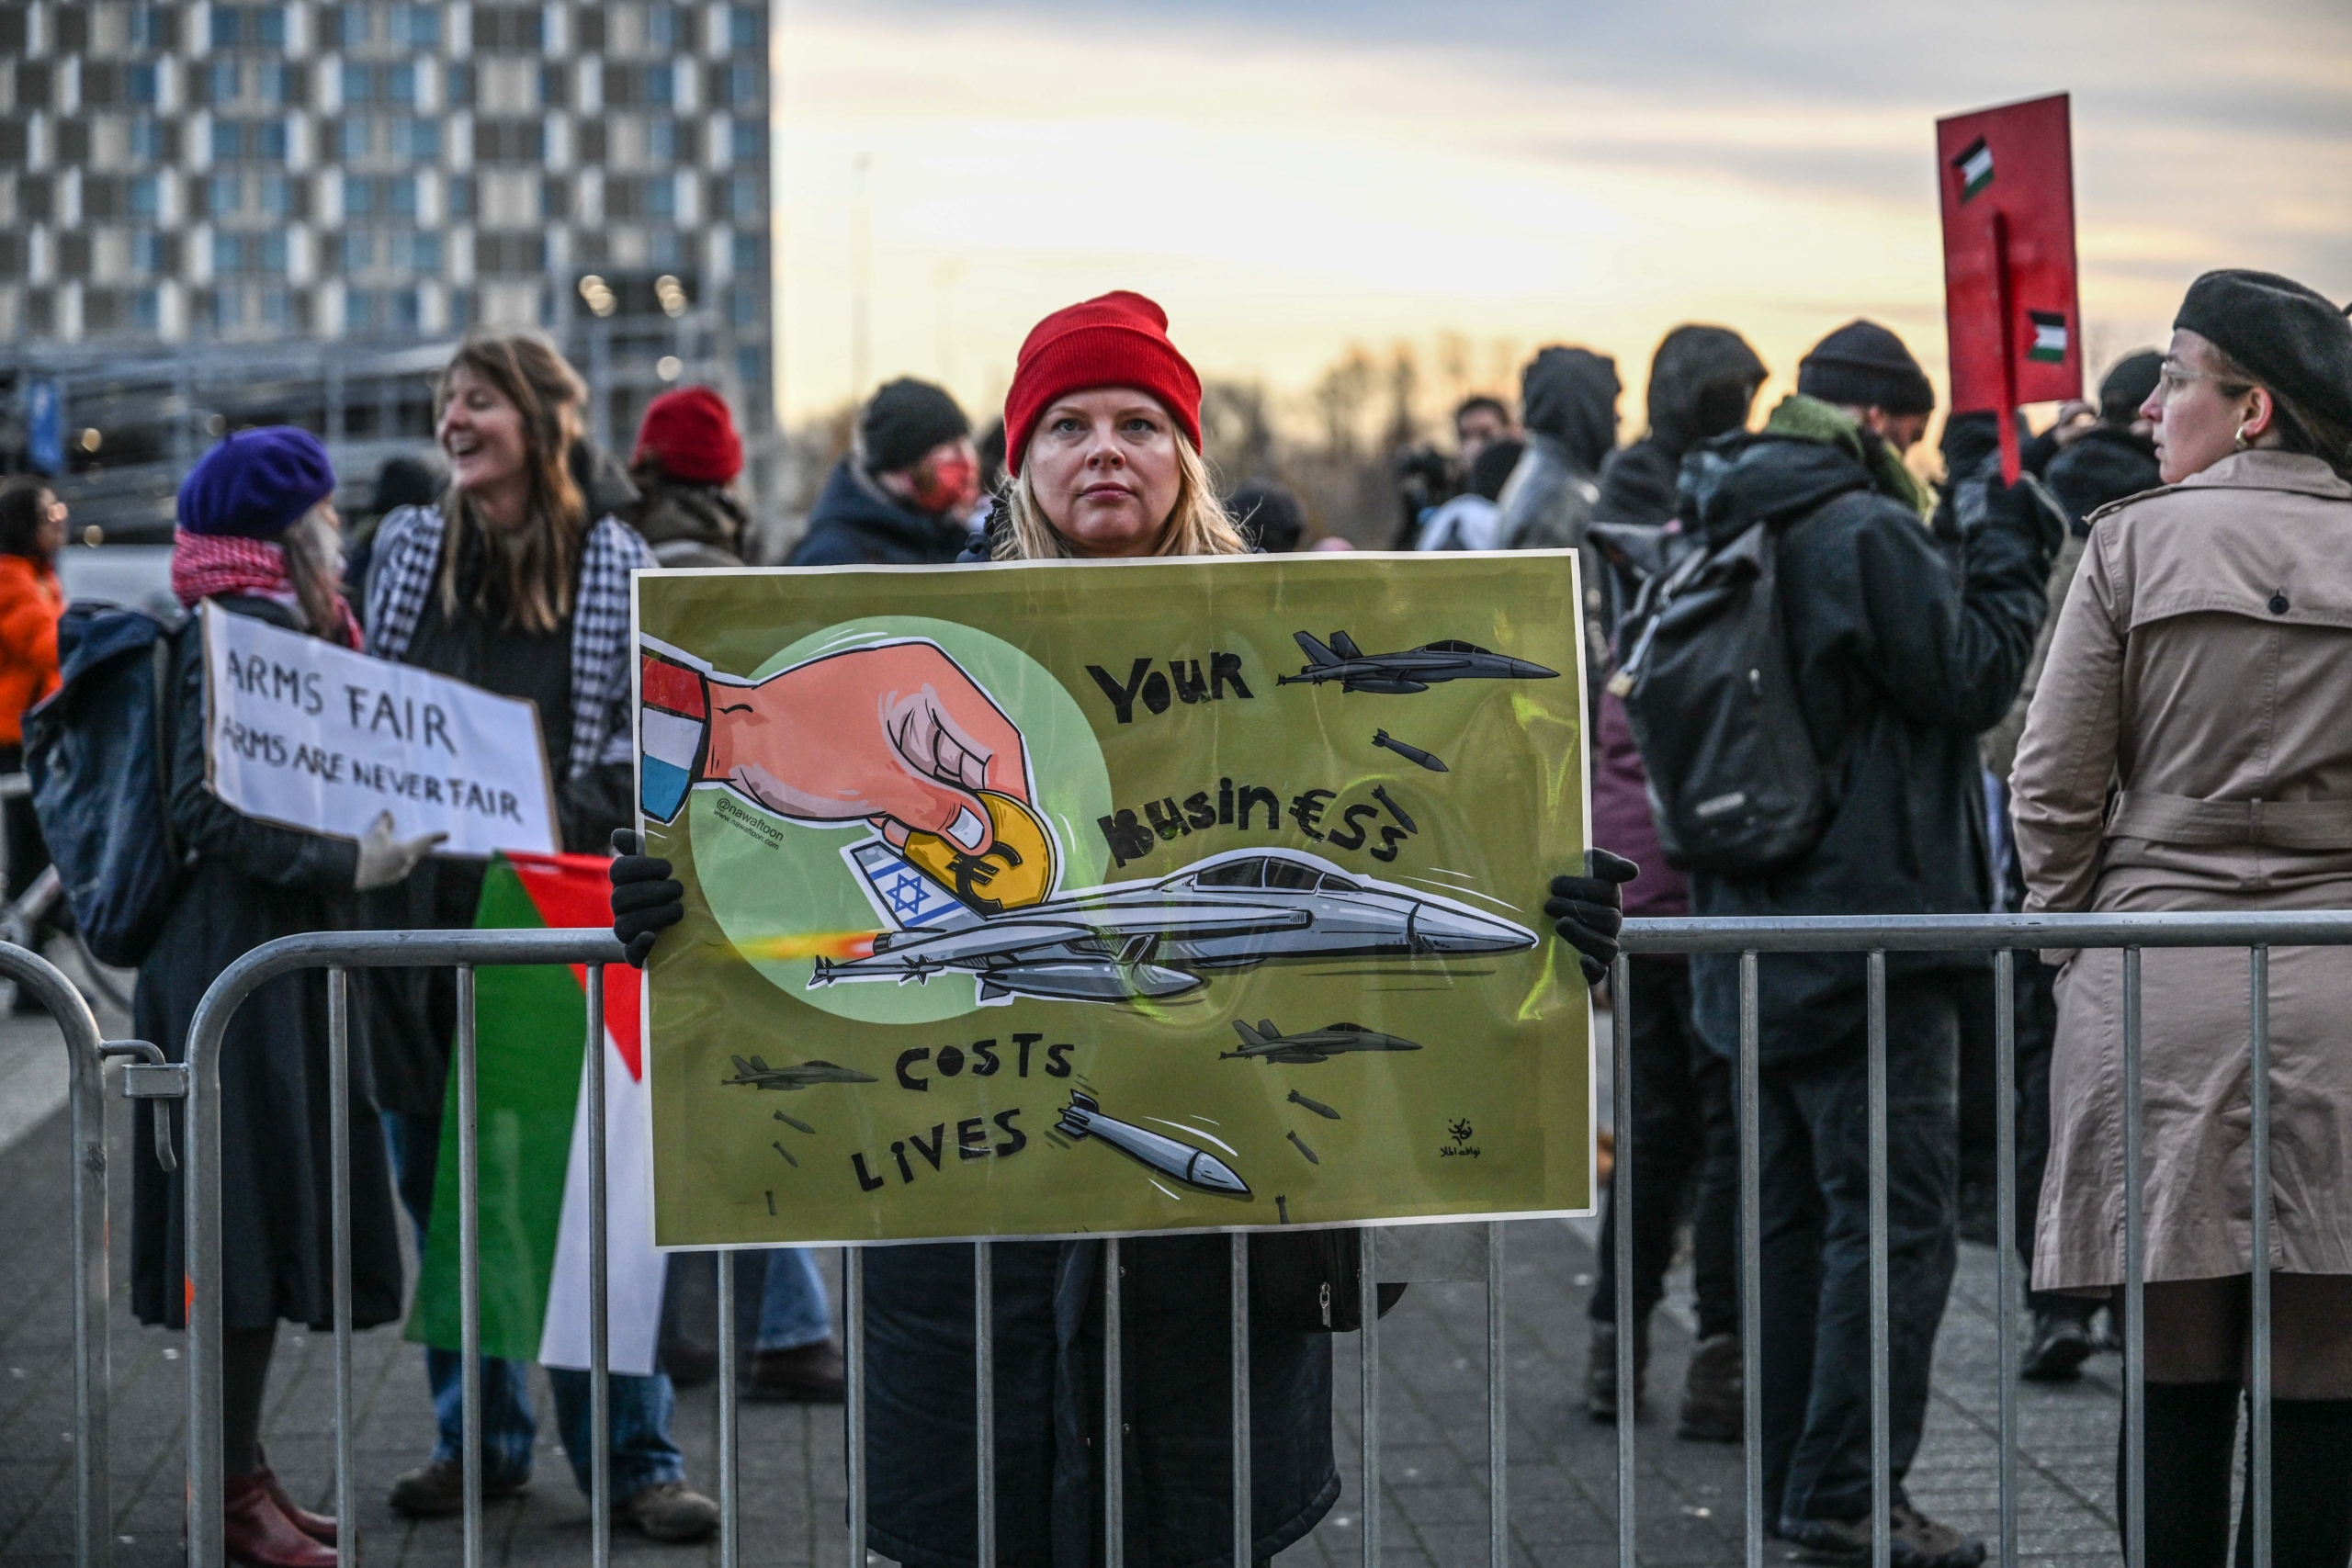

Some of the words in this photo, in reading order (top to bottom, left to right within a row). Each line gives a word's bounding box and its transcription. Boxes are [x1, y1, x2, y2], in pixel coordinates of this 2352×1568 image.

[227, 647, 323, 716] ARMS
[345, 682, 458, 757] FAIR
[222, 714, 288, 768] ARMS
[292, 742, 345, 783] ARE
[352, 759, 445, 807] NEVER
[446, 777, 525, 825] FAIR
[713, 809, 780, 851] www.nawaftoon.com
[717, 797, 784, 841] @nawaftoon
[896, 1032, 1074, 1091] COSTS
